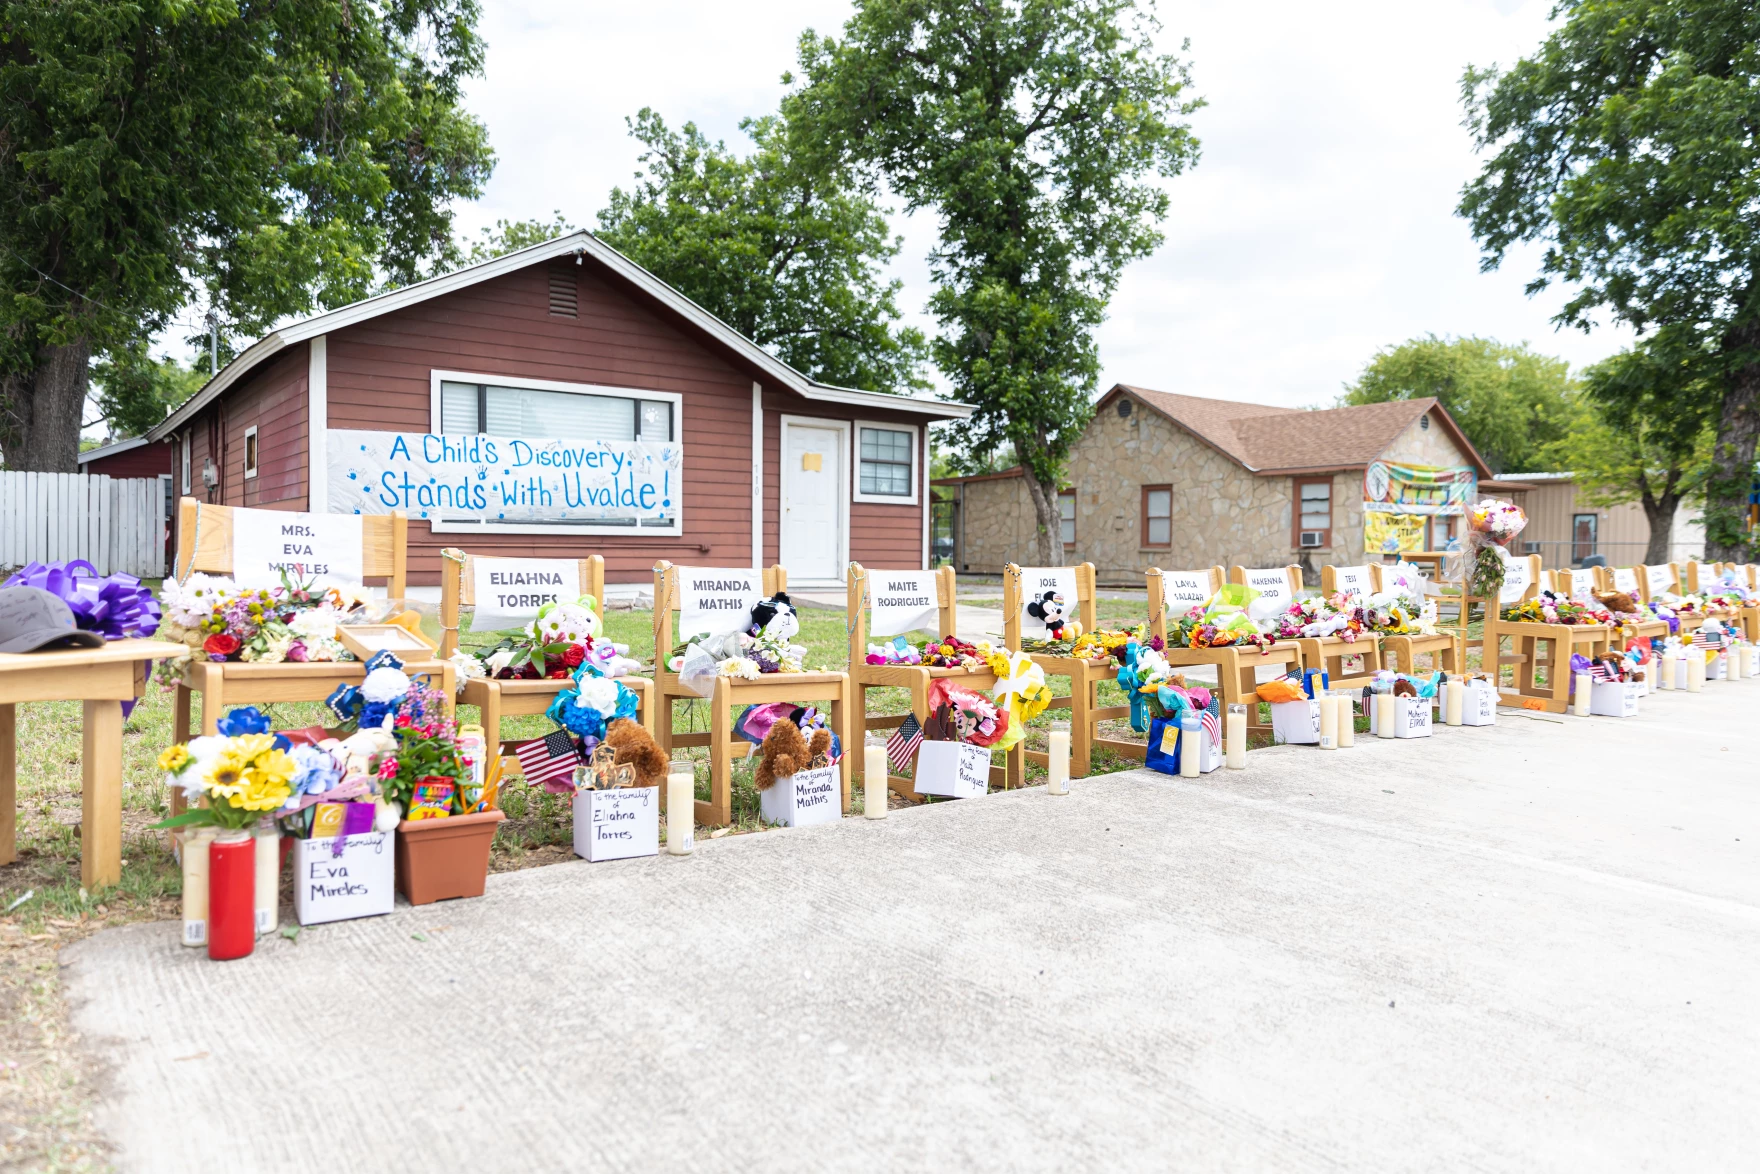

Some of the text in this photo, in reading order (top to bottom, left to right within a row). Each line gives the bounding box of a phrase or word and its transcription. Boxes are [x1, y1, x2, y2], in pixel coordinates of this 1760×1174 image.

[389, 434, 411, 461] A
[423, 434, 499, 467] Child's
[379, 469, 671, 510] Stands With Uvalde!
[281, 524, 315, 537] MRS.
[283, 543, 313, 556] EVA
[490, 572, 563, 586] ELIAHNA
[1039, 578, 1057, 588] JOSE
[1175, 580, 1198, 589] LAYLA
[1344, 575, 1357, 583] TESS
[693, 580, 751, 592] MIRANDA
[888, 581, 918, 592] MAITE
[877, 597, 930, 607] RODRIGUEZ
[1174, 592, 1204, 602] SALAZAR
[699, 598, 743, 610] MATHIS
[796, 783, 833, 796] Miranda
[593, 788, 651, 807] To the family
[796, 793, 828, 809] Mathis
[612, 800, 620, 809] of
[593, 809, 636, 822] Eliahna
[594, 824, 633, 840] Torres
[304, 841, 318, 851] To
[310, 860, 349, 879] Eva
[310, 882, 368, 901] Mireles
